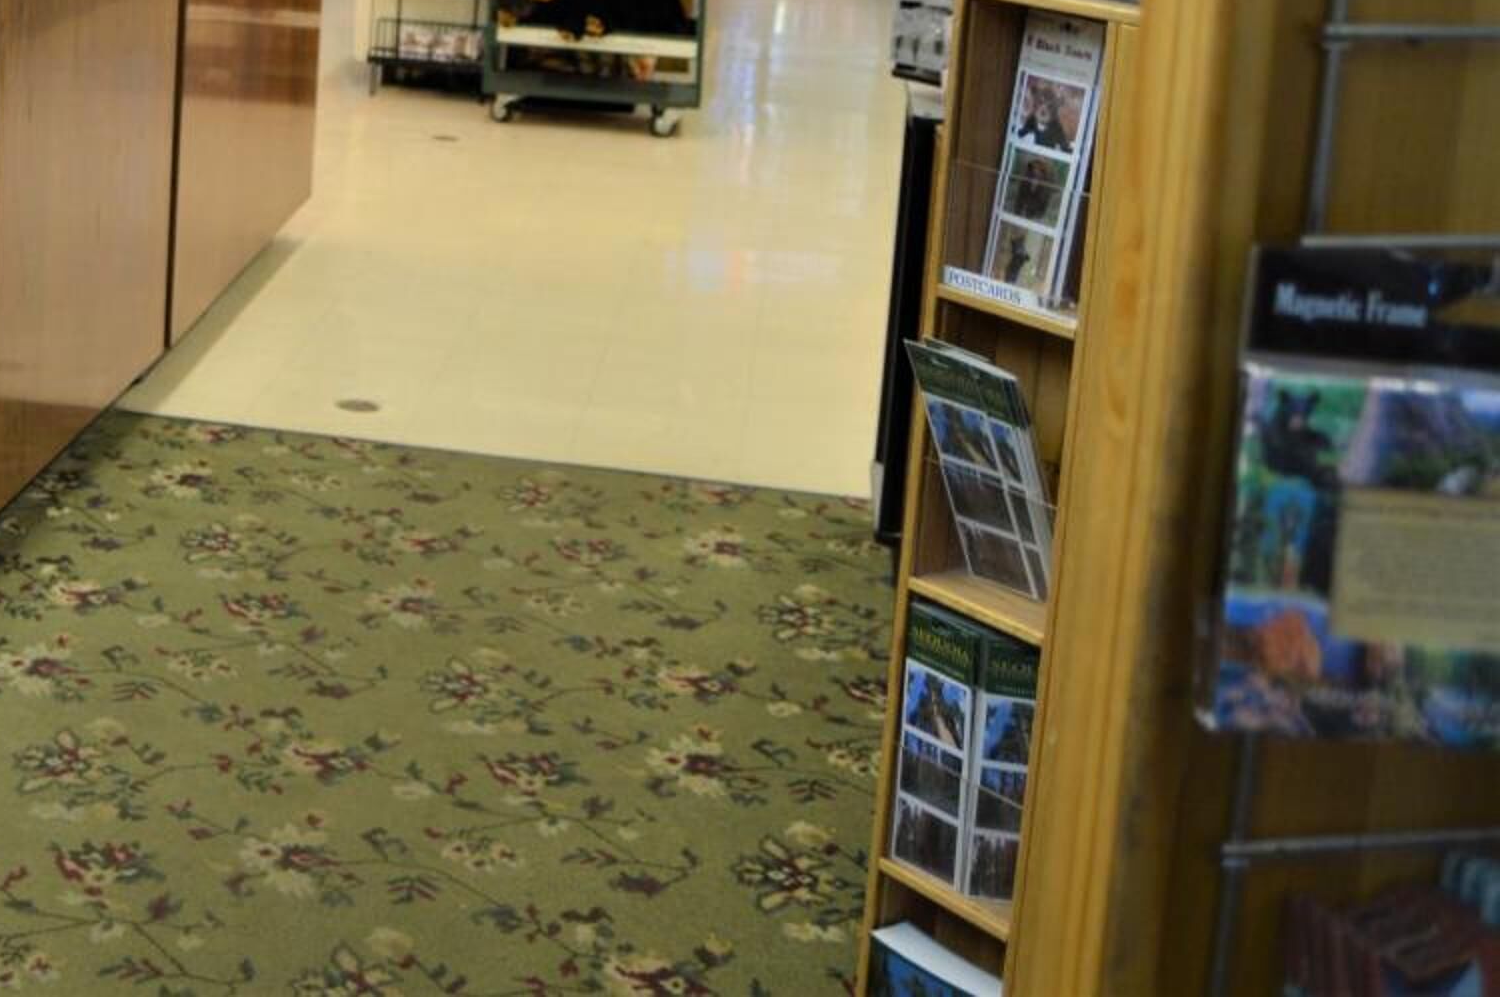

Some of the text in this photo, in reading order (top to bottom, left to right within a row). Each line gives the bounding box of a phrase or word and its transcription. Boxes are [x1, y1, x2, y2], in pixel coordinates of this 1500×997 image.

[949, 268, 1021, 305] POSTCARDS
[1274, 282, 1428, 329] Magnetic Frame
